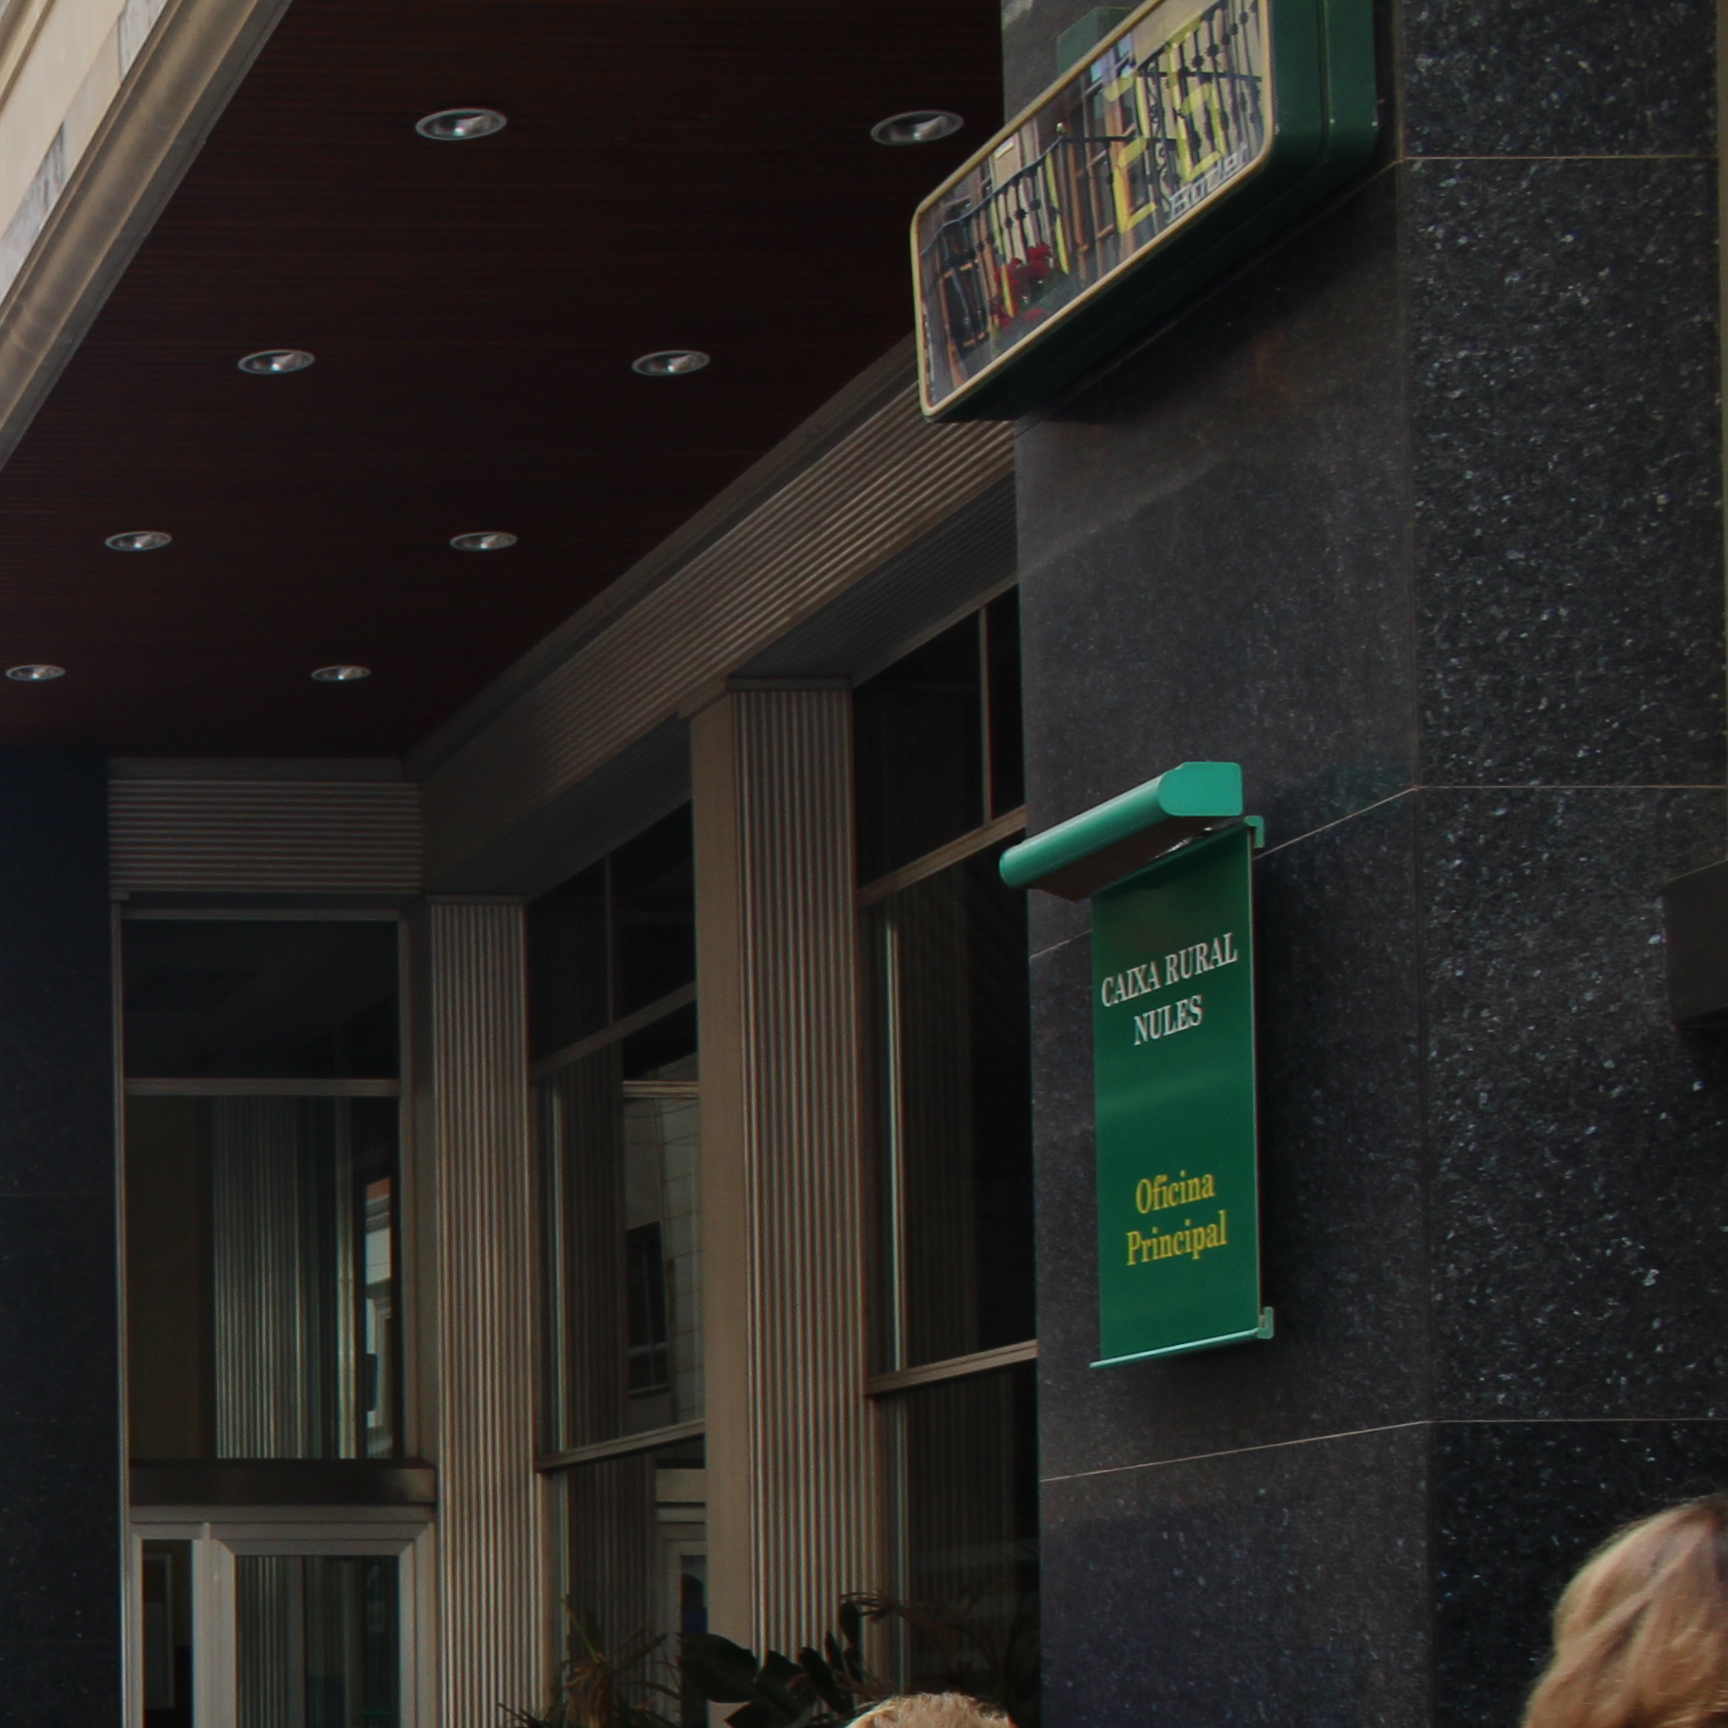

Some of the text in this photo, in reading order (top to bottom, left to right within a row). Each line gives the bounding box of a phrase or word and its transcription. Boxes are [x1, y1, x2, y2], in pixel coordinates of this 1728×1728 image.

[1166, 143, 1248, 223] Bodet
[1100, 932, 1239, 1007] CAIXA RURAL
[1133, 994, 1204, 1046] NULES
[1136, 1170, 1217, 1214] Oficina
[1126, 1209, 1229, 1266] Principal
